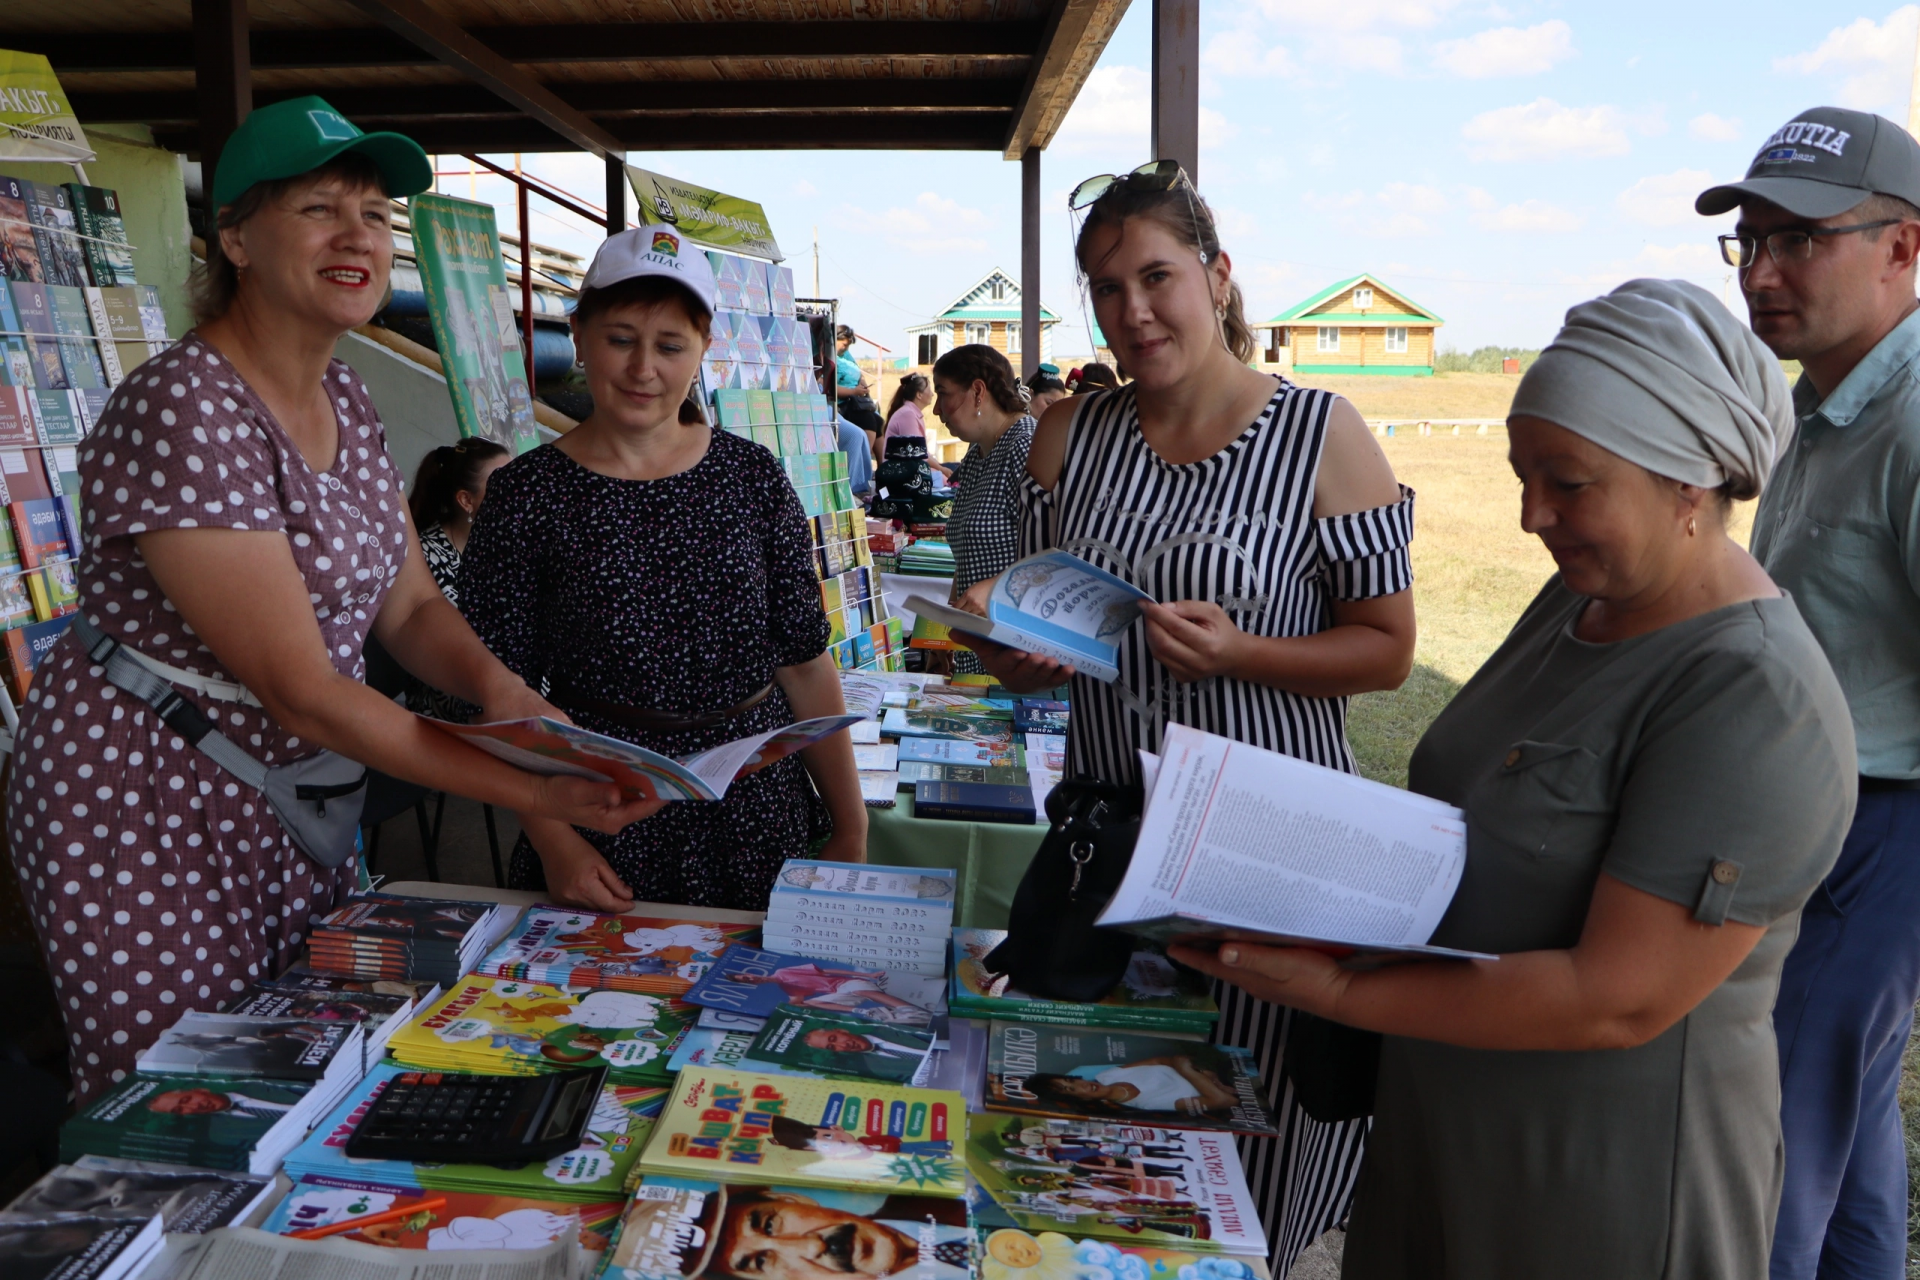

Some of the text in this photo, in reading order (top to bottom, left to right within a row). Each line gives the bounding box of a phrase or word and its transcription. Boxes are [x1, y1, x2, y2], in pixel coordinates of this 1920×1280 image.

[10, 182, 19, 198] 8
[57, 193, 65, 208] 9
[104, 196, 115, 210] 10
[640, 253, 685, 271] АПАС
[34, 293, 43, 308] 8
[91, 298, 122, 388] РОГРАММА
[22, 414, 31, 429] 6
[57, 602, 66, 617] 3
[4, 614, 14, 631] 2
[419, 984, 490, 1030] БУЯГЫЧ
[774, 1018, 805, 1054] КОПЧЁНЫЙ
[302, 1025, 345, 1067] ИЗГЕ АТ
[725, 1083, 788, 1166] КЫЧЛАР
[315, 1178, 403, 1194] АФРИКА ХАЙВАННАРЫ
[1198, 1137, 1245, 1238] МИЛЛИ СӘЯХӘТ
